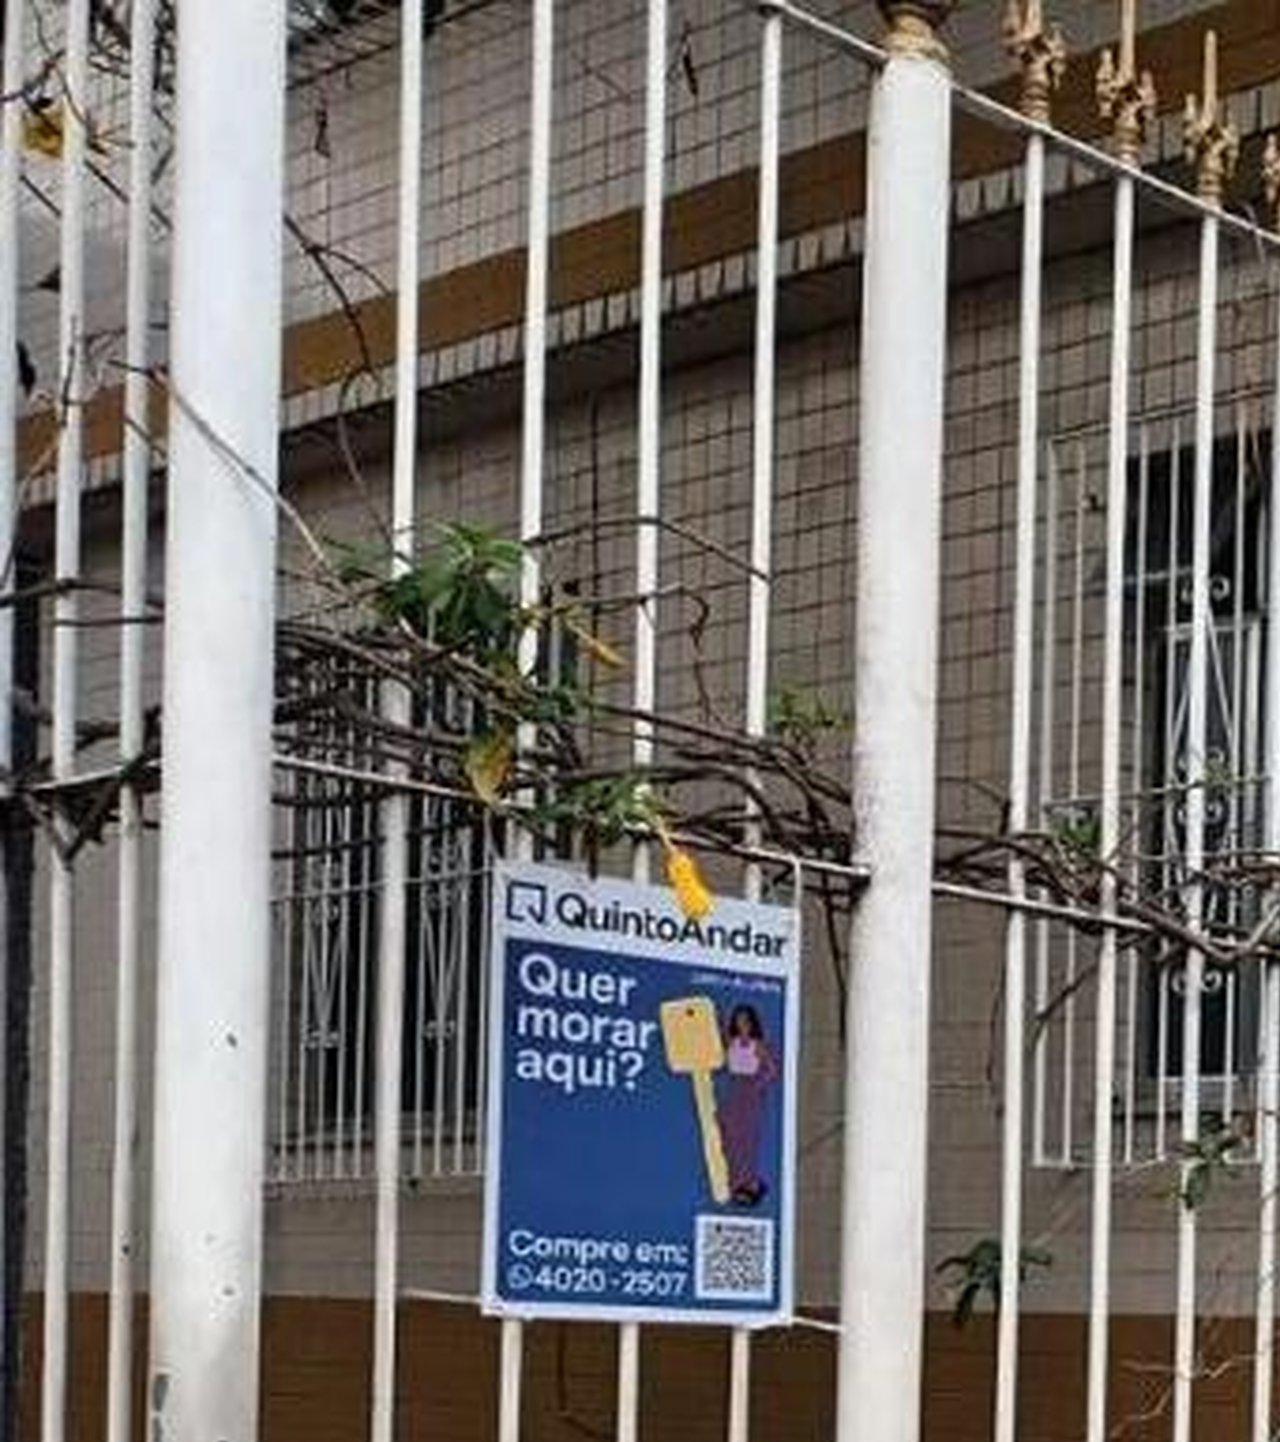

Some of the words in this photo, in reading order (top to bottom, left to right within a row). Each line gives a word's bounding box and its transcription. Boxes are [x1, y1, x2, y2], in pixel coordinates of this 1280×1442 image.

[555, 892, 787, 958] QuintoAndar
[518, 952, 637, 1007] Quer
[516, 1003, 658, 1050] morar
[515, 1048, 644, 1094] aqui?
[508, 1228, 631, 1266] Compre
[635, 1241, 689, 1266] em:
